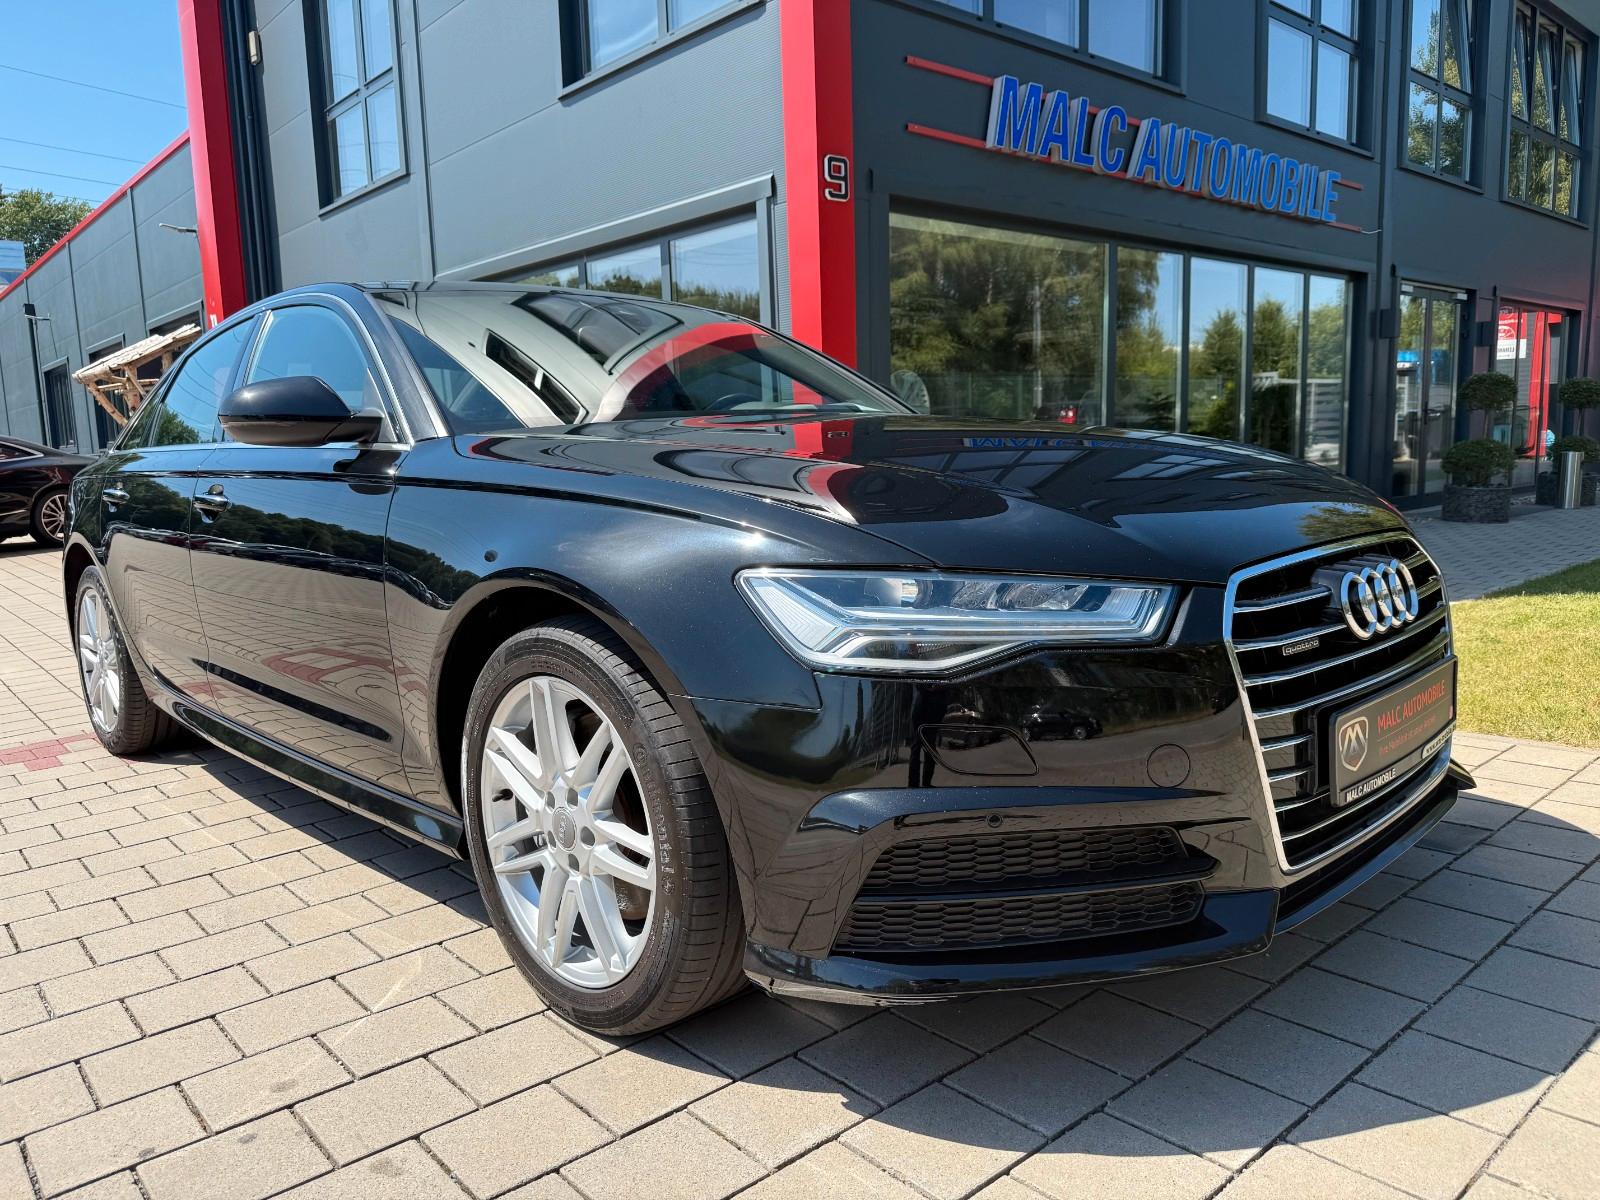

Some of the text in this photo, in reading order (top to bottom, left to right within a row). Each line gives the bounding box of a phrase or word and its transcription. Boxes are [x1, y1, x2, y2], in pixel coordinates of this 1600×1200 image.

[988, 75, 1341, 222] MALC AUTOMOBILE
[823, 154, 850, 201] 9
[1285, 639, 1319, 654] quattro
[1377, 680, 1445, 735] MALC AUTOMOBILE
[1346, 768, 1396, 803] MALC AUTOMOBILE
